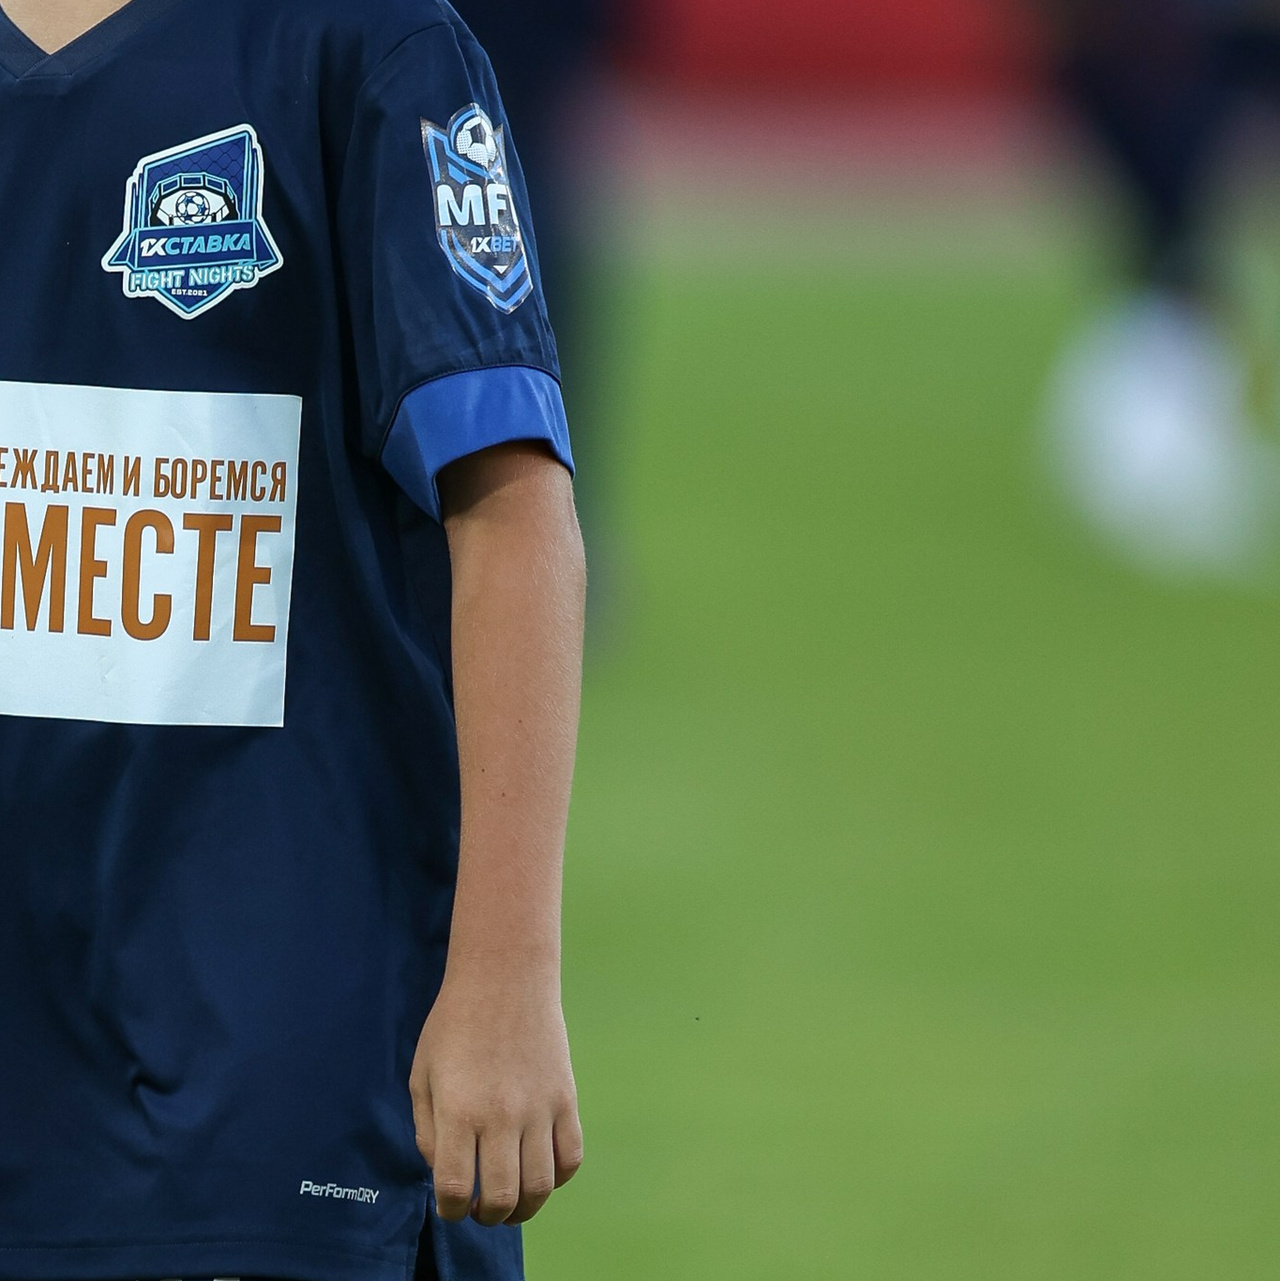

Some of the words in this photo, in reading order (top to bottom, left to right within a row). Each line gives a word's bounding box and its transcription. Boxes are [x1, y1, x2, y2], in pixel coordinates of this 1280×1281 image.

[129, 269, 185, 292] FIGHT
[188, 265, 254, 287] NIGHTS
[122, 455, 142, 497] И
[153, 457, 287, 502] БОРЕМСЯ
